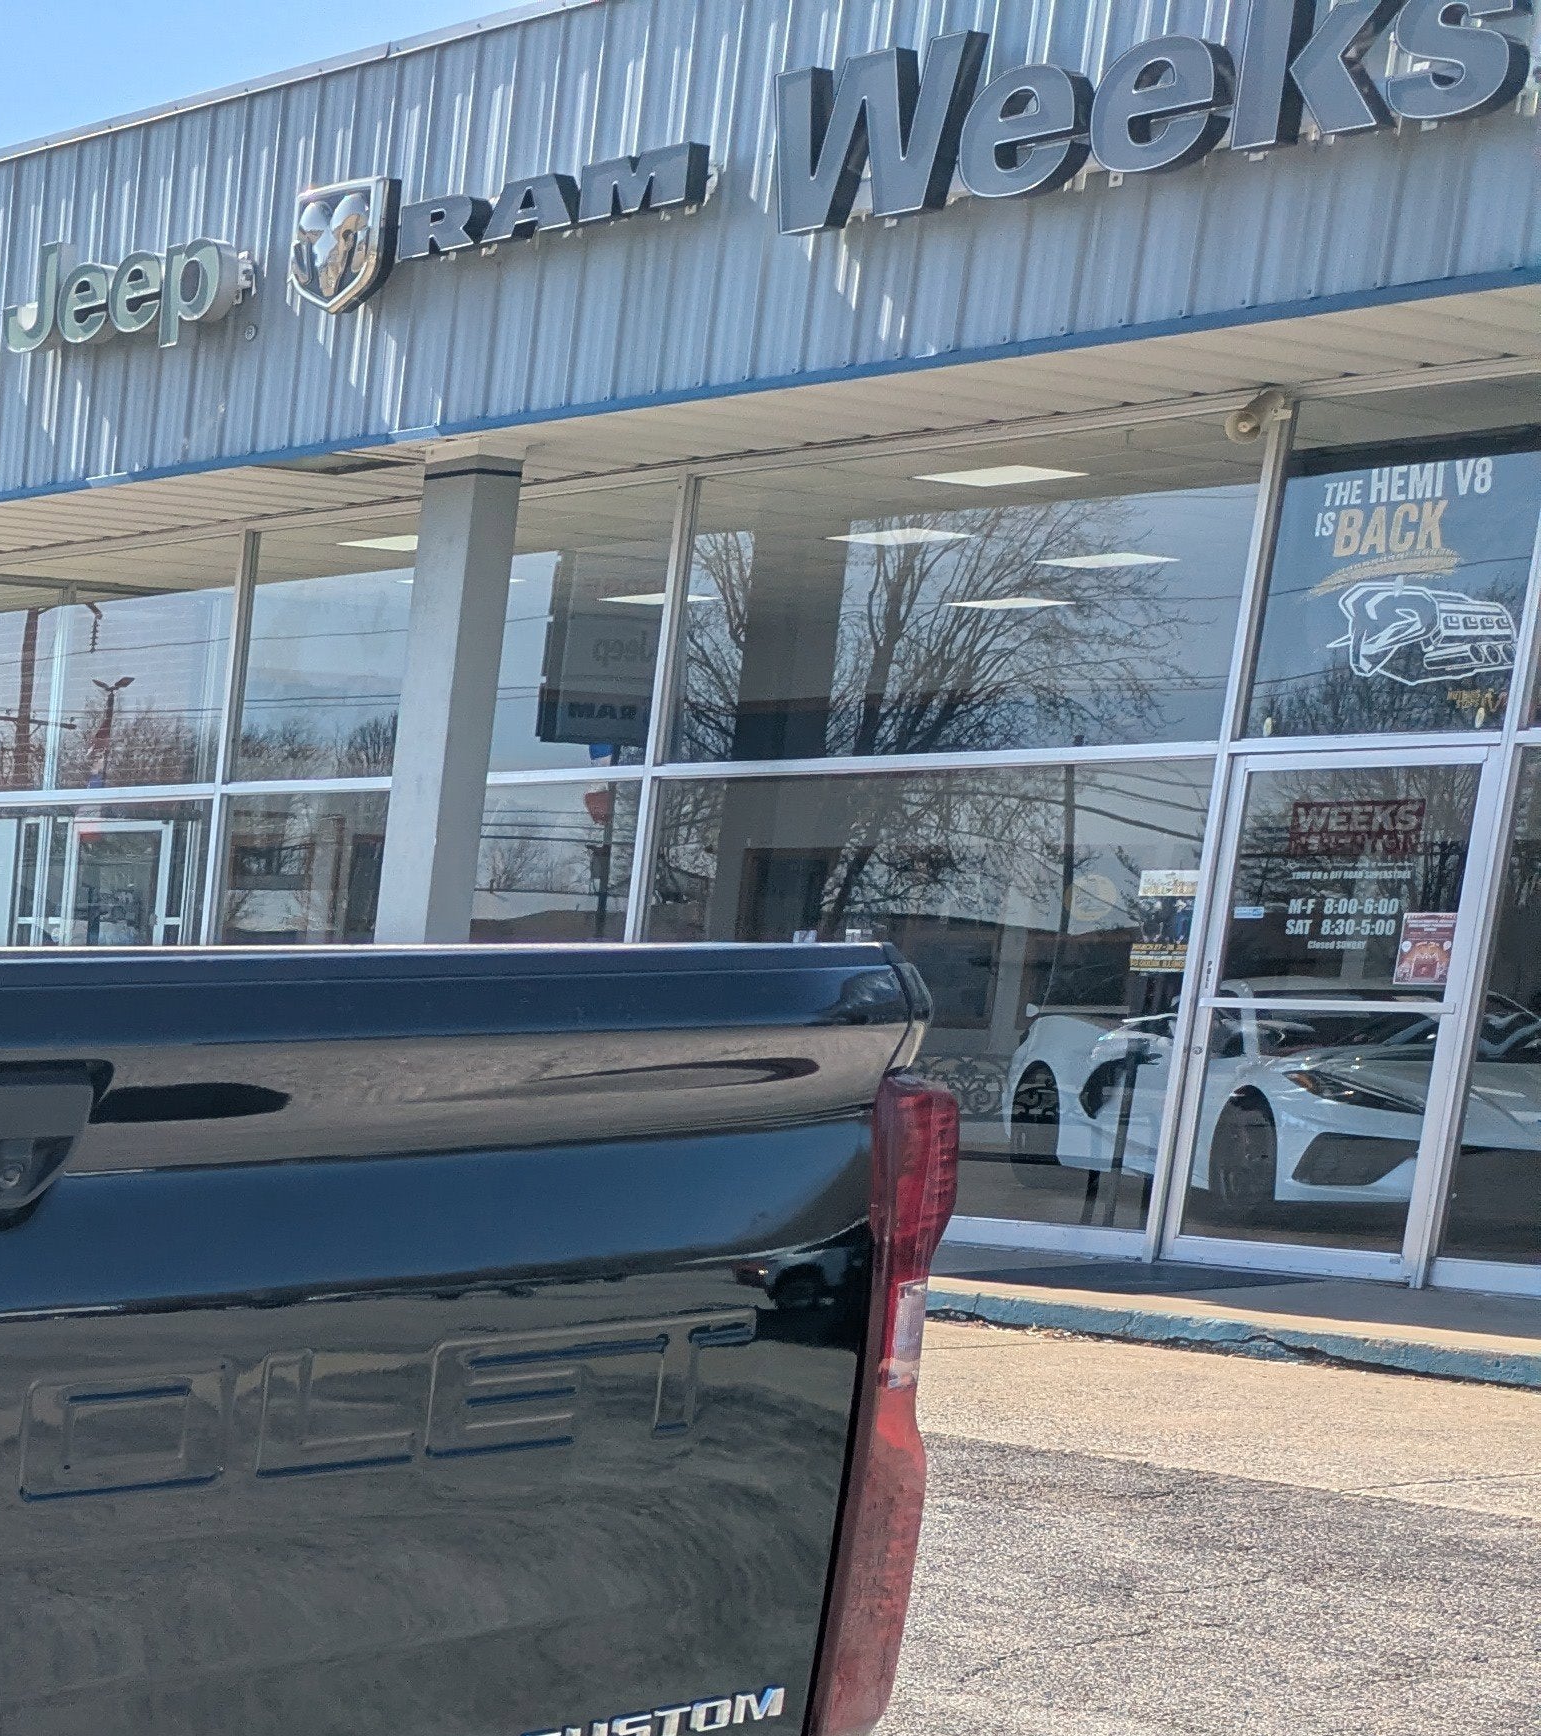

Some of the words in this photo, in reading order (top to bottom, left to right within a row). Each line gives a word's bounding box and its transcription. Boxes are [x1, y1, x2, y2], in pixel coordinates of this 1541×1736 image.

[775, 0, 1522, 236] Weeks
[400, 141, 703, 261] RAM
[3, 237, 227, 352] Jeep
[1324, 479, 1364, 507] THE
[1369, 461, 1445, 504] HEMI
[1455, 457, 1493, 496] V8
[1314, 511, 1336, 537] IS
[1333, 499, 1449, 557] BACK
[1297, 802, 1421, 832] WEEKS
[1285, 919, 1313, 935] SAT
[1321, 918, 1396, 935] 8:30-5:00
[1288, 898, 1316, 914] M-F
[1323, 898, 1399, 915] 8:00-6:00
